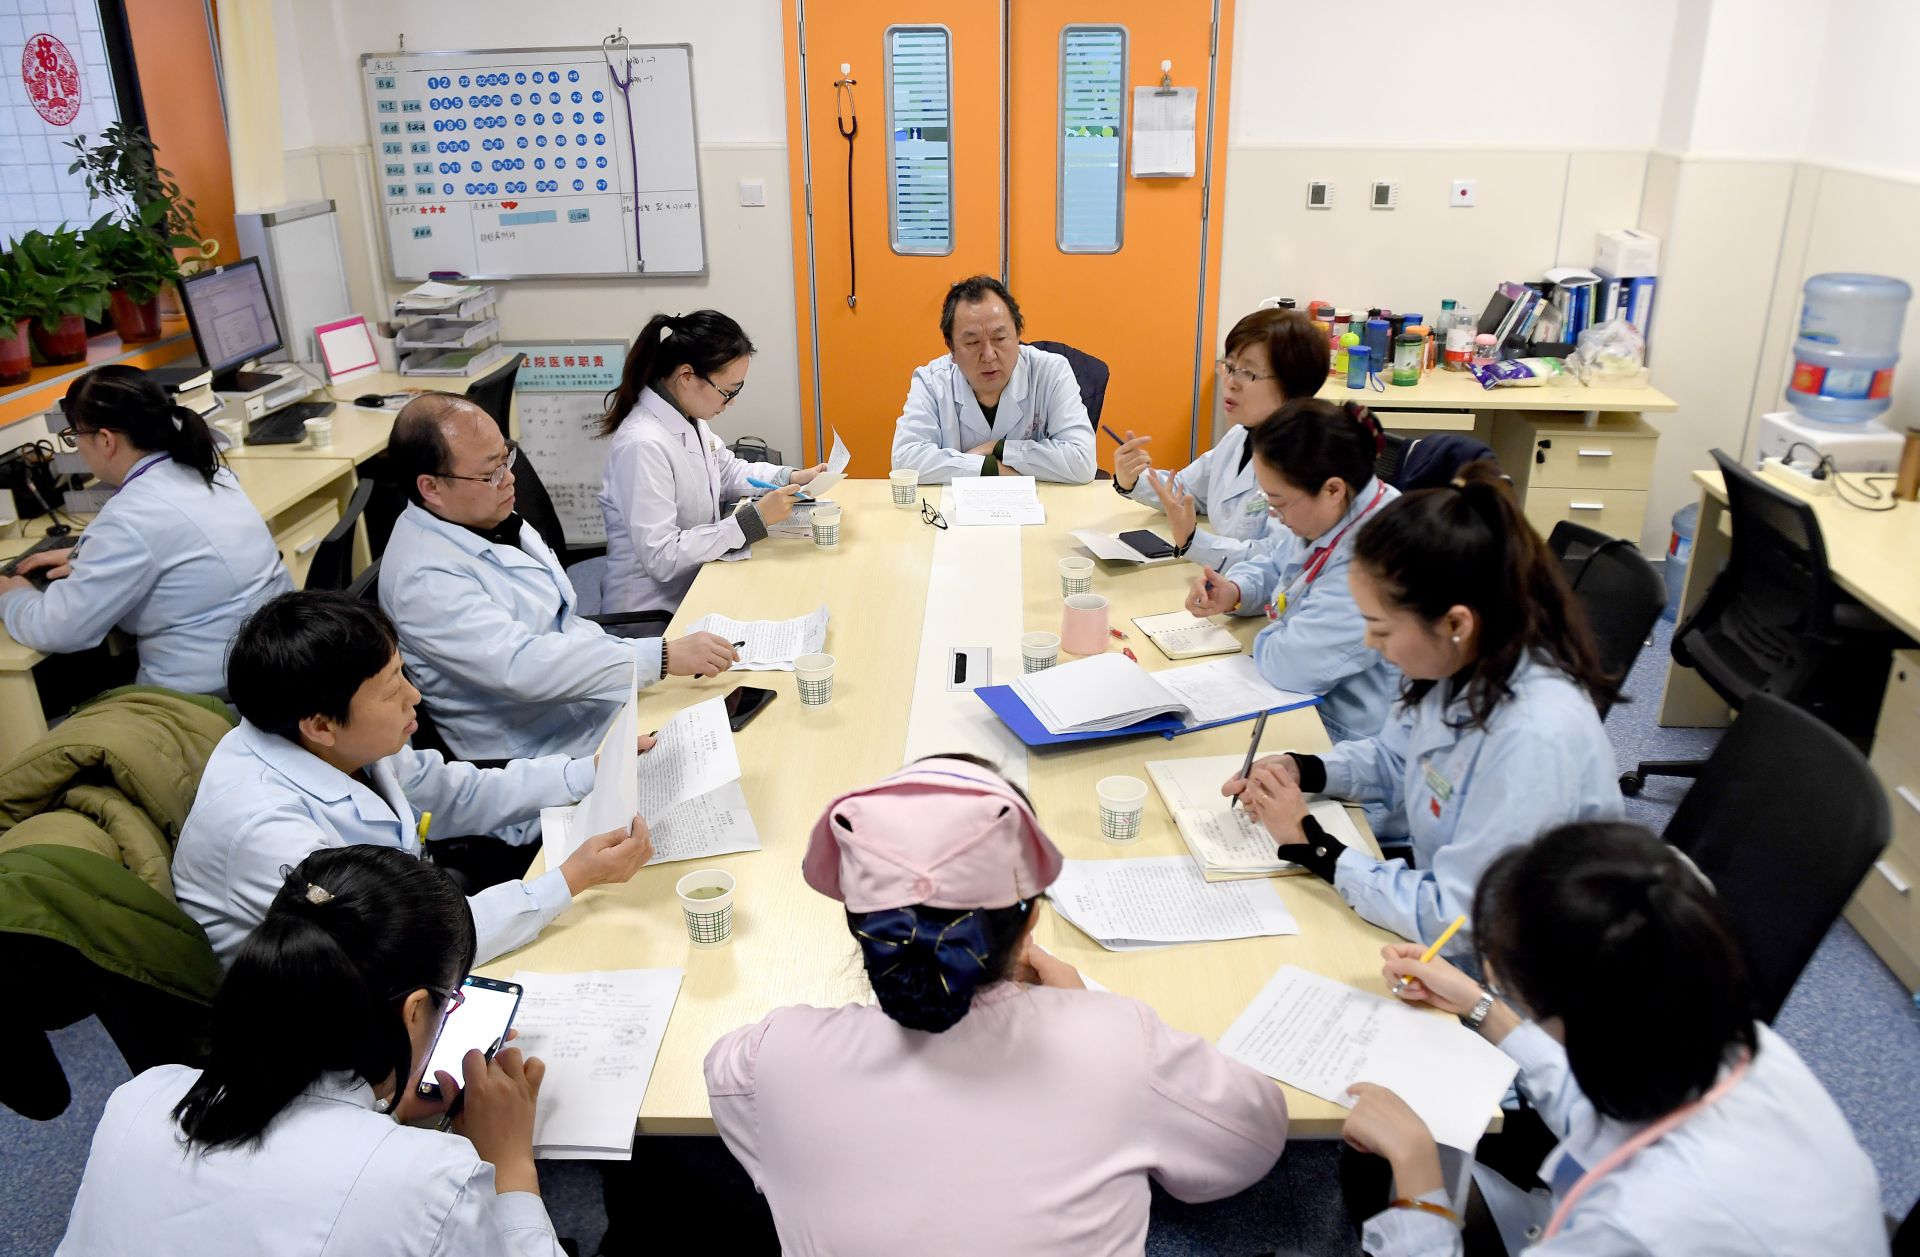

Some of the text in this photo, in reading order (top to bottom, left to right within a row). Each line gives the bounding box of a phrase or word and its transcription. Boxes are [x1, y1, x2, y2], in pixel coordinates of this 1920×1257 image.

[459, 77, 470, 86] 22
[476, 77, 487, 86] 32
[488, 76, 498, 85] 33
[498, 75, 509, 84] 34
[515, 74, 526, 83] 44
[549, 73, 559, 82] +1
[468, 98, 479, 107] 23
[480, 97, 490, 106] 24
[492, 96, 502, 105] 25
[510, 95, 521, 104] 39
[530, 94, 540, 103] 43
[571, 93, 582, 102] +2
[485, 118, 495, 127] 37
[515, 116, 525, 124] 42
[533, 115, 544, 124] 47
[574, 113, 584, 122] +3
[437, 143, 447, 152] 12
[448, 142, 458, 151] 13
[459, 141, 470, 150] 14
[494, 139, 504, 148] 31
[451, 163, 461, 172] 11
[472, 161, 482, 170] 15
[492, 162, 502, 171] 16
[502, 160, 513, 169] 17
[514, 159, 524, 168] 18
[534, 160, 544, 168] 41
[465, 185, 475, 194] 19
[488, 183, 498, 192] 21
[517, 182, 527, 191] 27
[597, 180, 608, 188] +7
